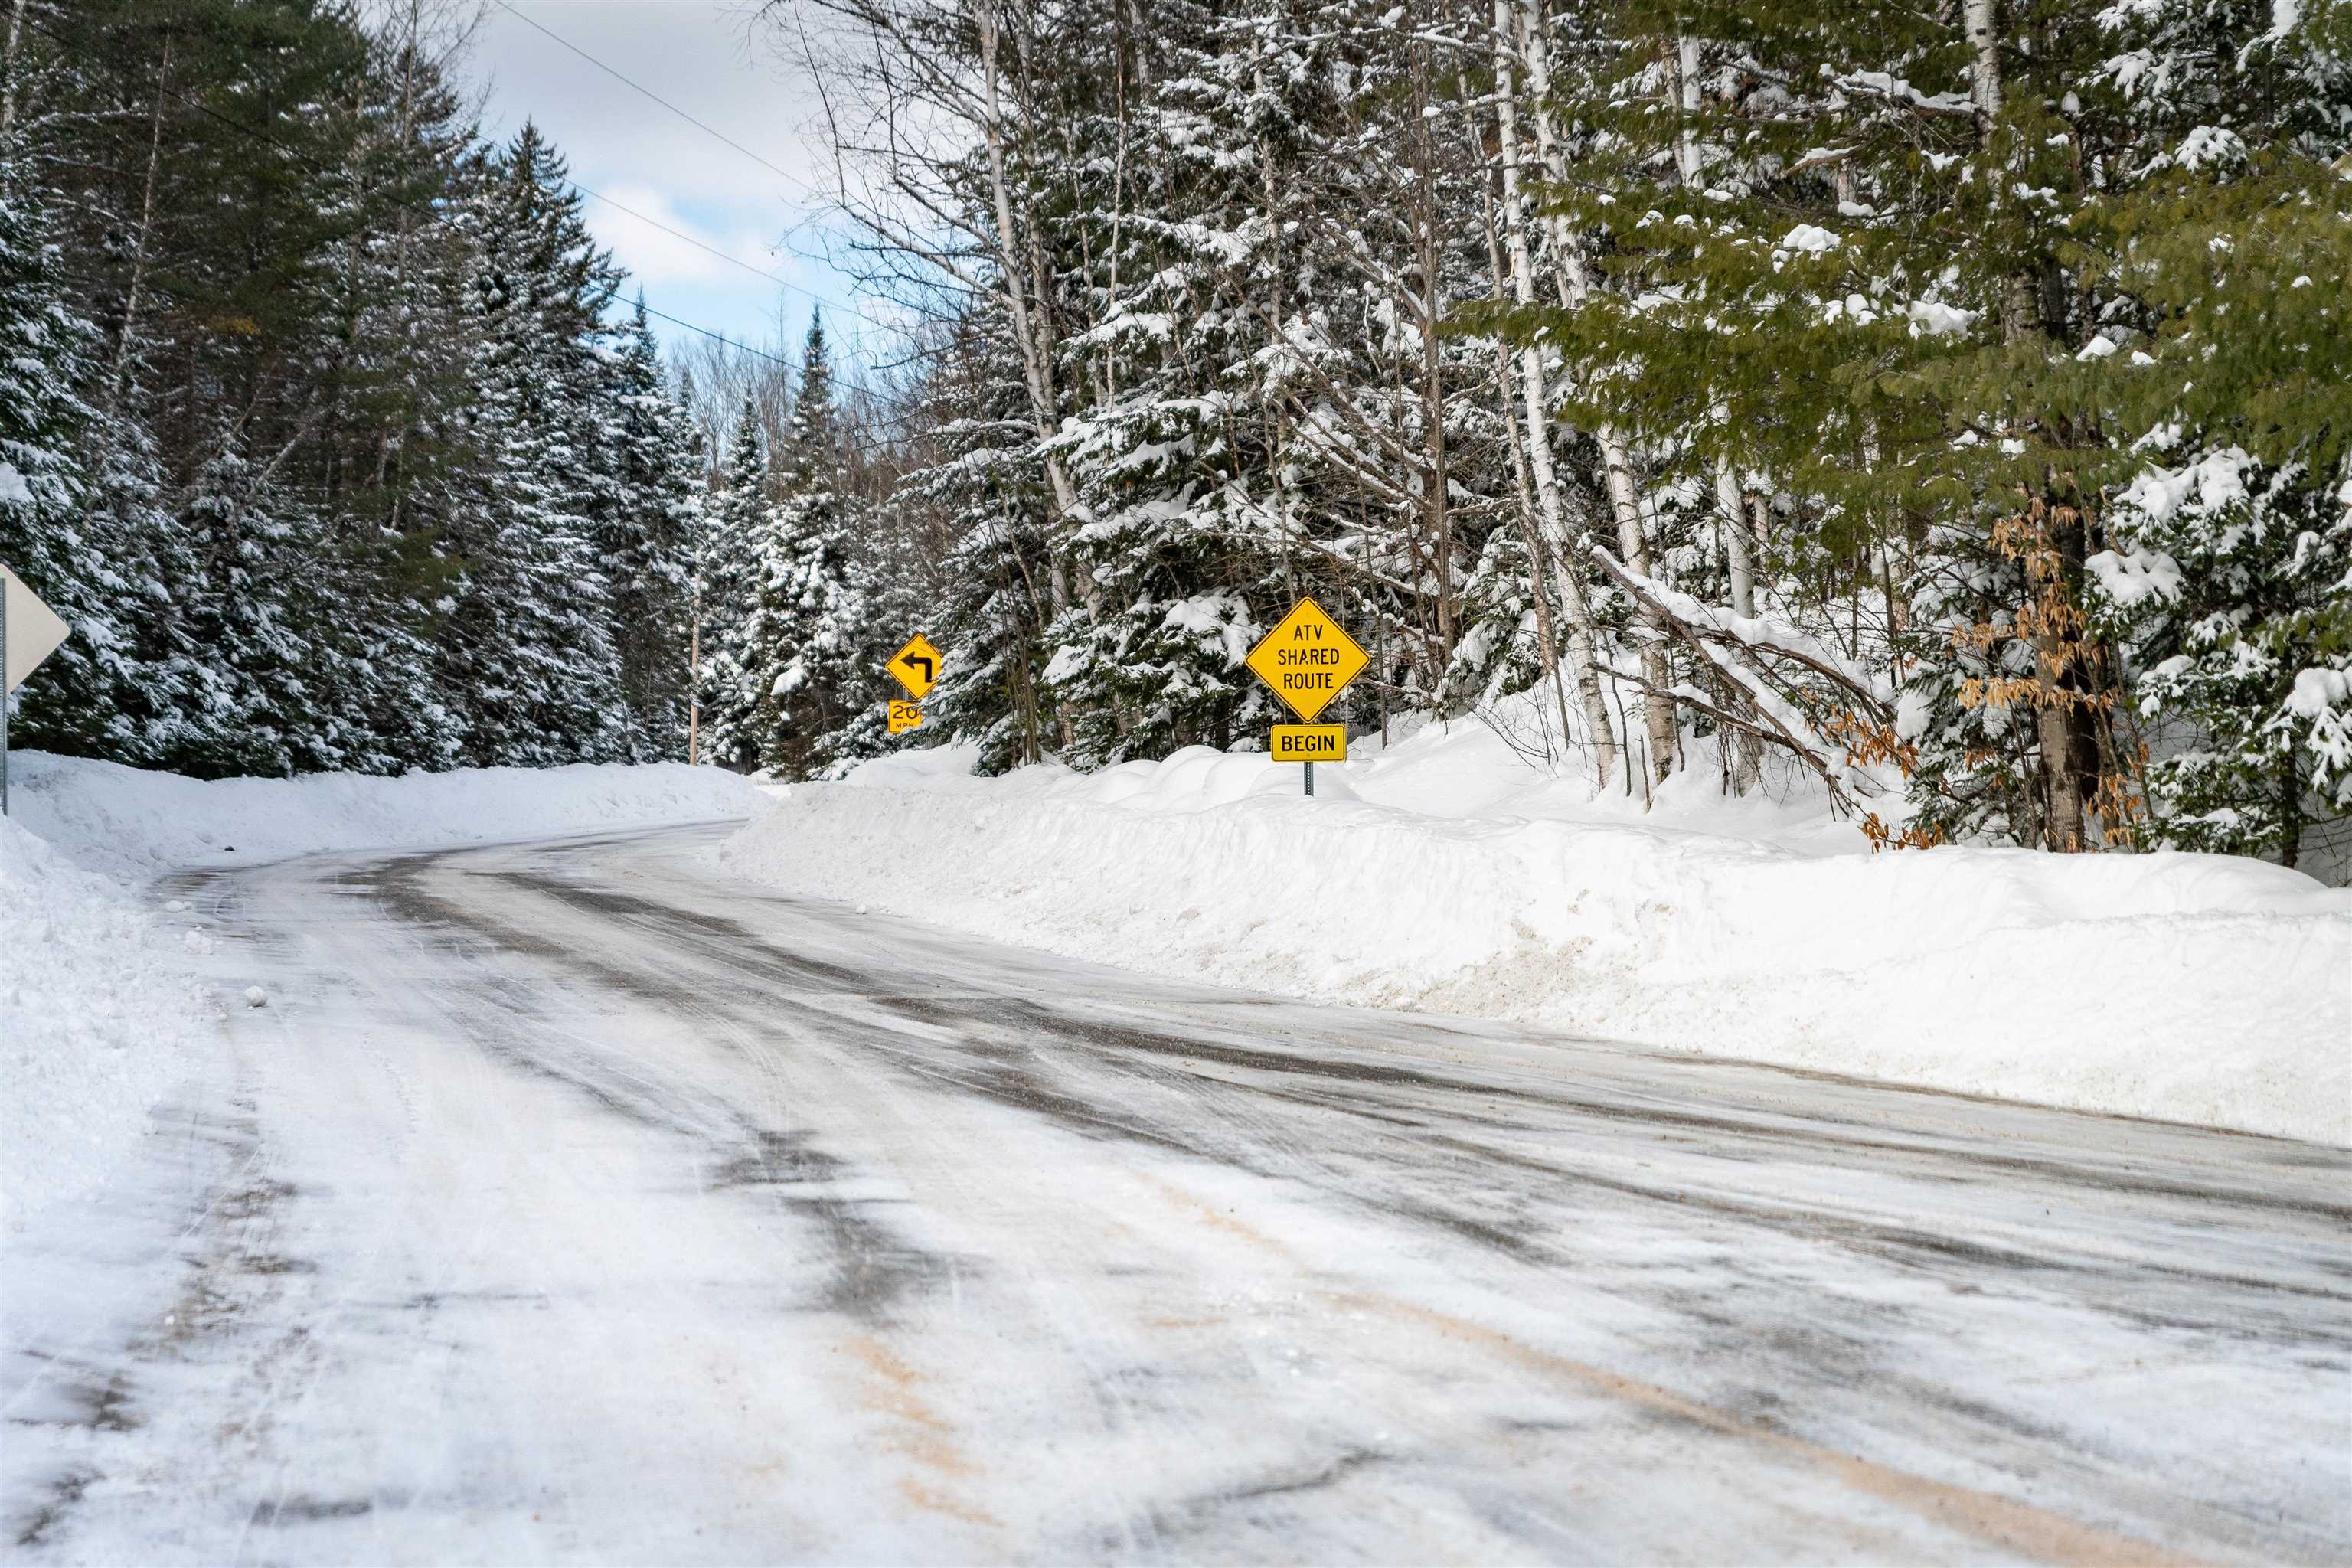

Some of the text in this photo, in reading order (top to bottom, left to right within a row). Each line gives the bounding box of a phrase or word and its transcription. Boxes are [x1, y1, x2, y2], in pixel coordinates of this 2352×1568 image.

[1293, 625, 1324, 641] ATV
[1277, 648, 1340, 665] SHARED
[1283, 673, 1334, 689] ROUTE
[893, 705, 918, 720] 20
[1281, 735, 1334, 752] BEGIN
